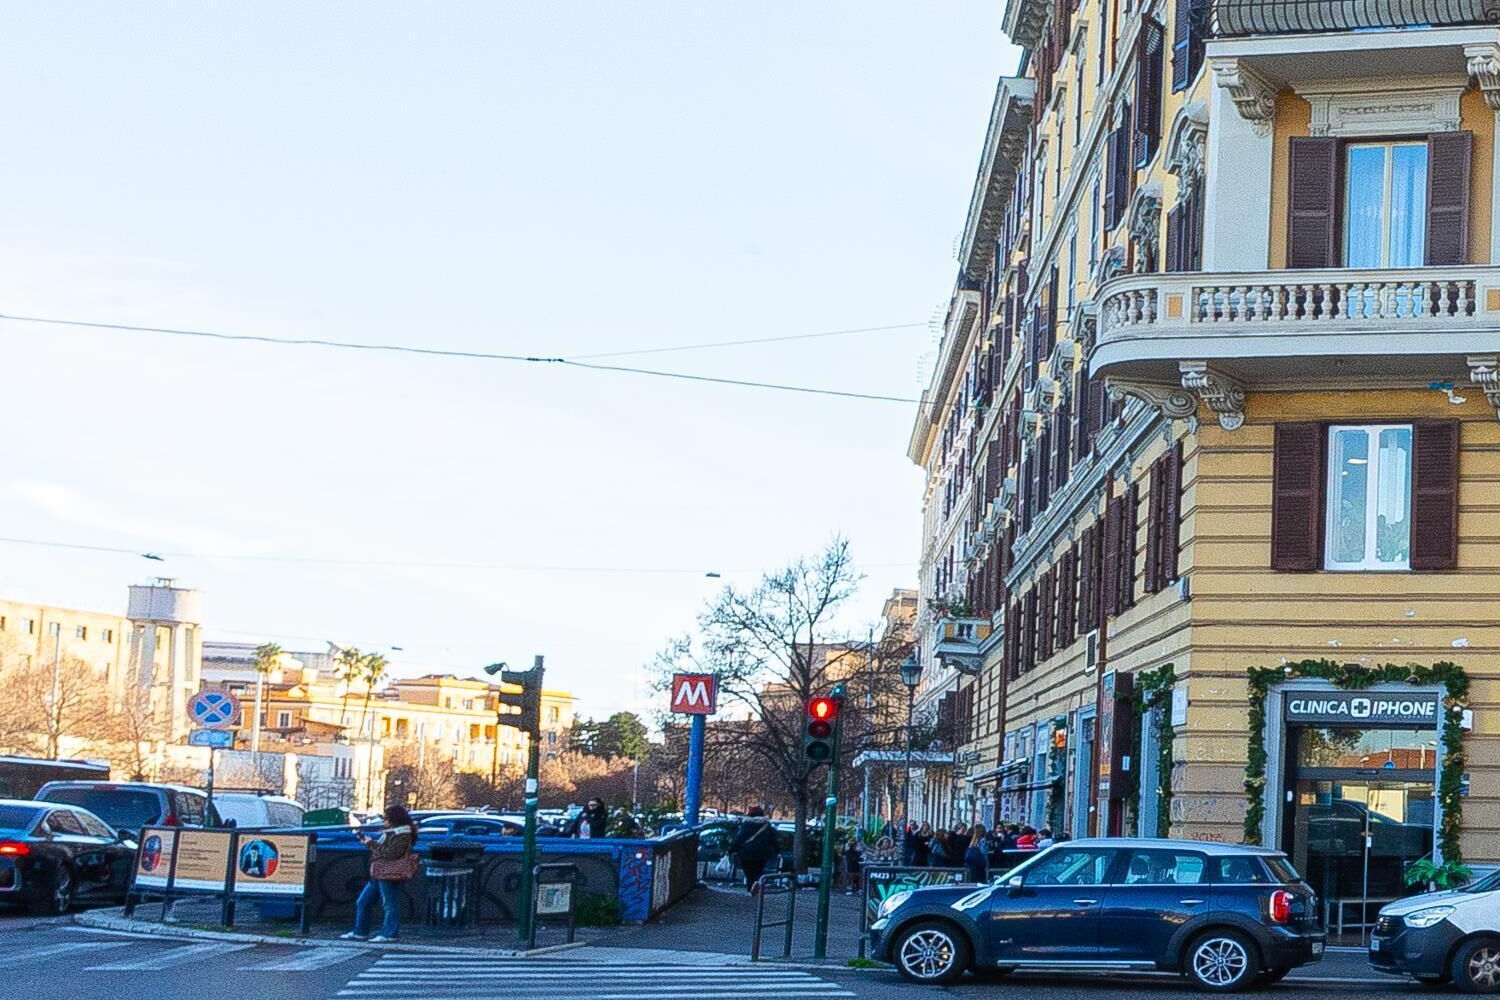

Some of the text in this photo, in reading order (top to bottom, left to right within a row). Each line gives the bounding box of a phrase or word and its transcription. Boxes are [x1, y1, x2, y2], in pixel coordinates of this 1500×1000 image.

[674, 681, 710, 706] M
[1289, 700, 1436, 716] CLINICA IPHONE
